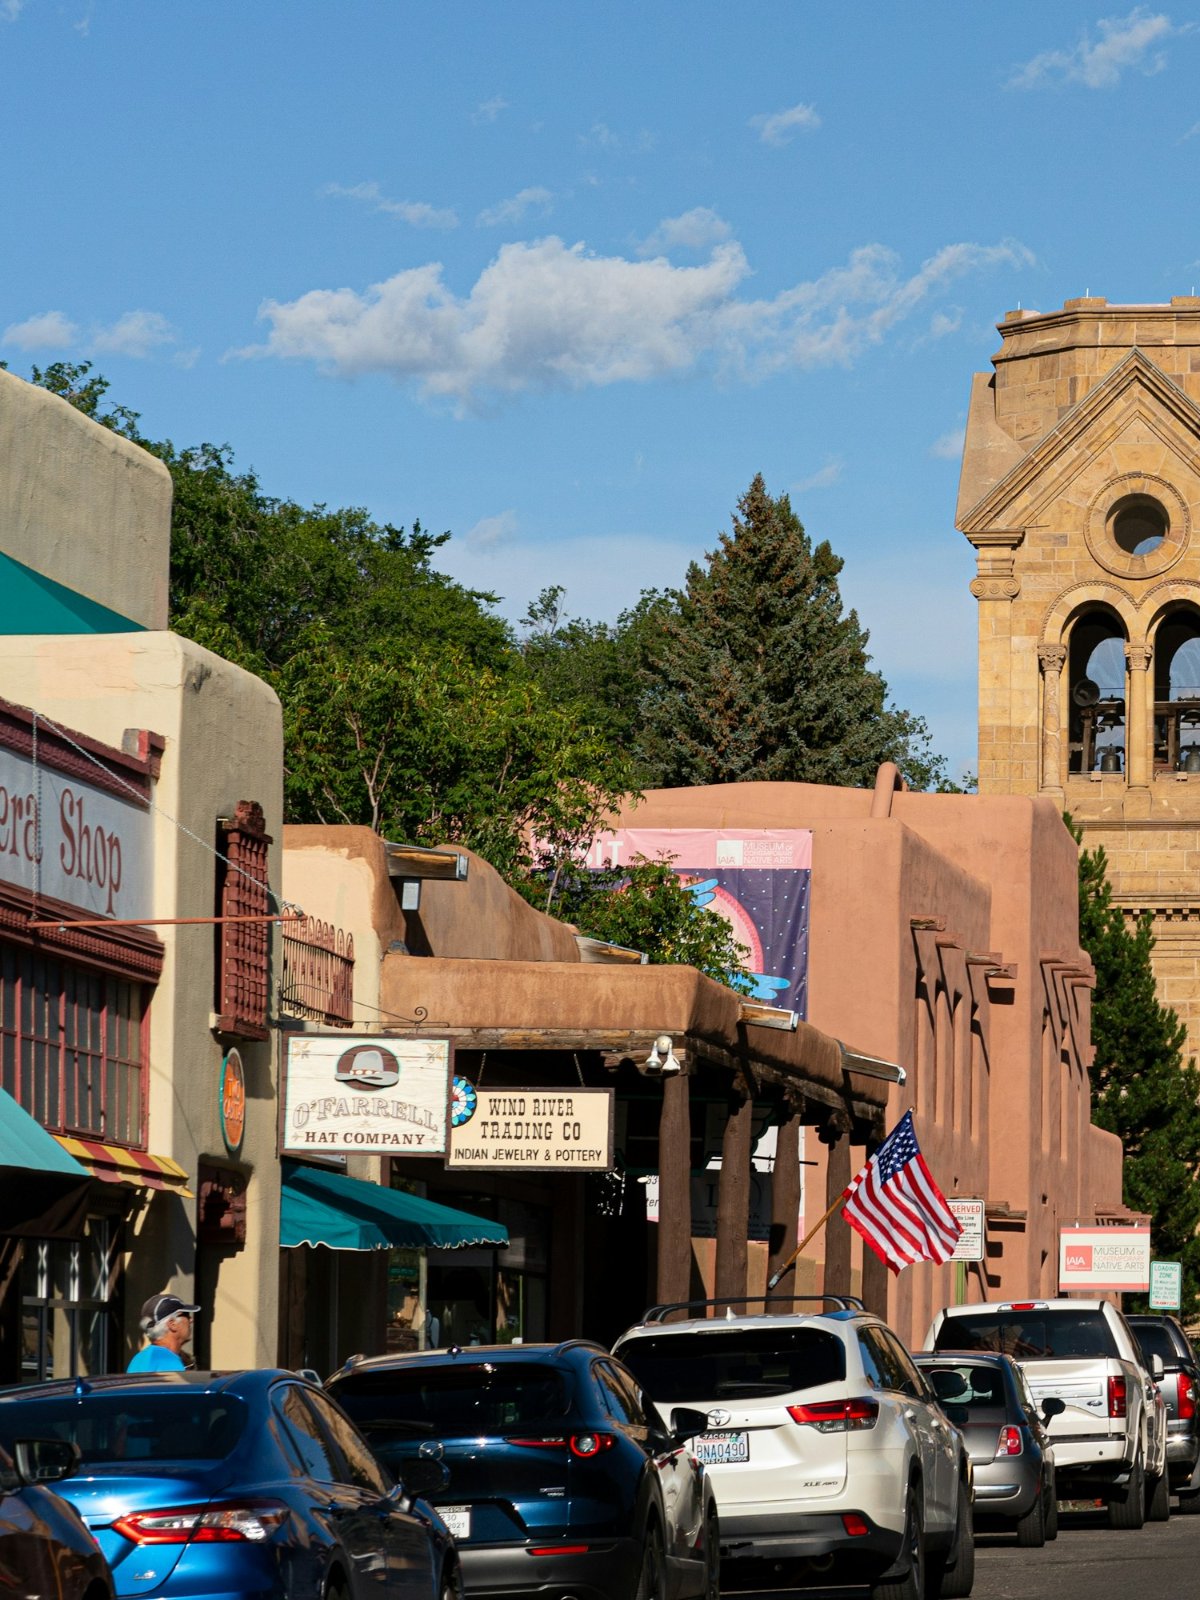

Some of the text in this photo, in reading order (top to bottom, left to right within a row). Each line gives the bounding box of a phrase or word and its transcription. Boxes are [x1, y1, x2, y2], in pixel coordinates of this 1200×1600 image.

[60, 788, 122, 917] Shop
[744, 842, 784, 851] MUSEUM
[744, 857, 792, 865] NATIVE ARTS
[488, 1098, 574, 1116] WIND RIVER
[292, 1097, 438, 1132] O'FARRELL
[481, 1121, 581, 1141] TRADING CO
[305, 1132, 425, 1145] HAT COMPANY
[454, 1148, 602, 1161] INDIAN JEWELRY & POTTERY
[1094, 1247, 1135, 1256] MUSEUM
[1066, 1256, 1086, 1266] IAIA
[1094, 1262, 1123, 1270] NATIVE
[1124, 1262, 1144, 1270] ARTS
[703, 1432, 739, 1440] TACOMA
[697, 1442, 745, 1459] BNA0490
